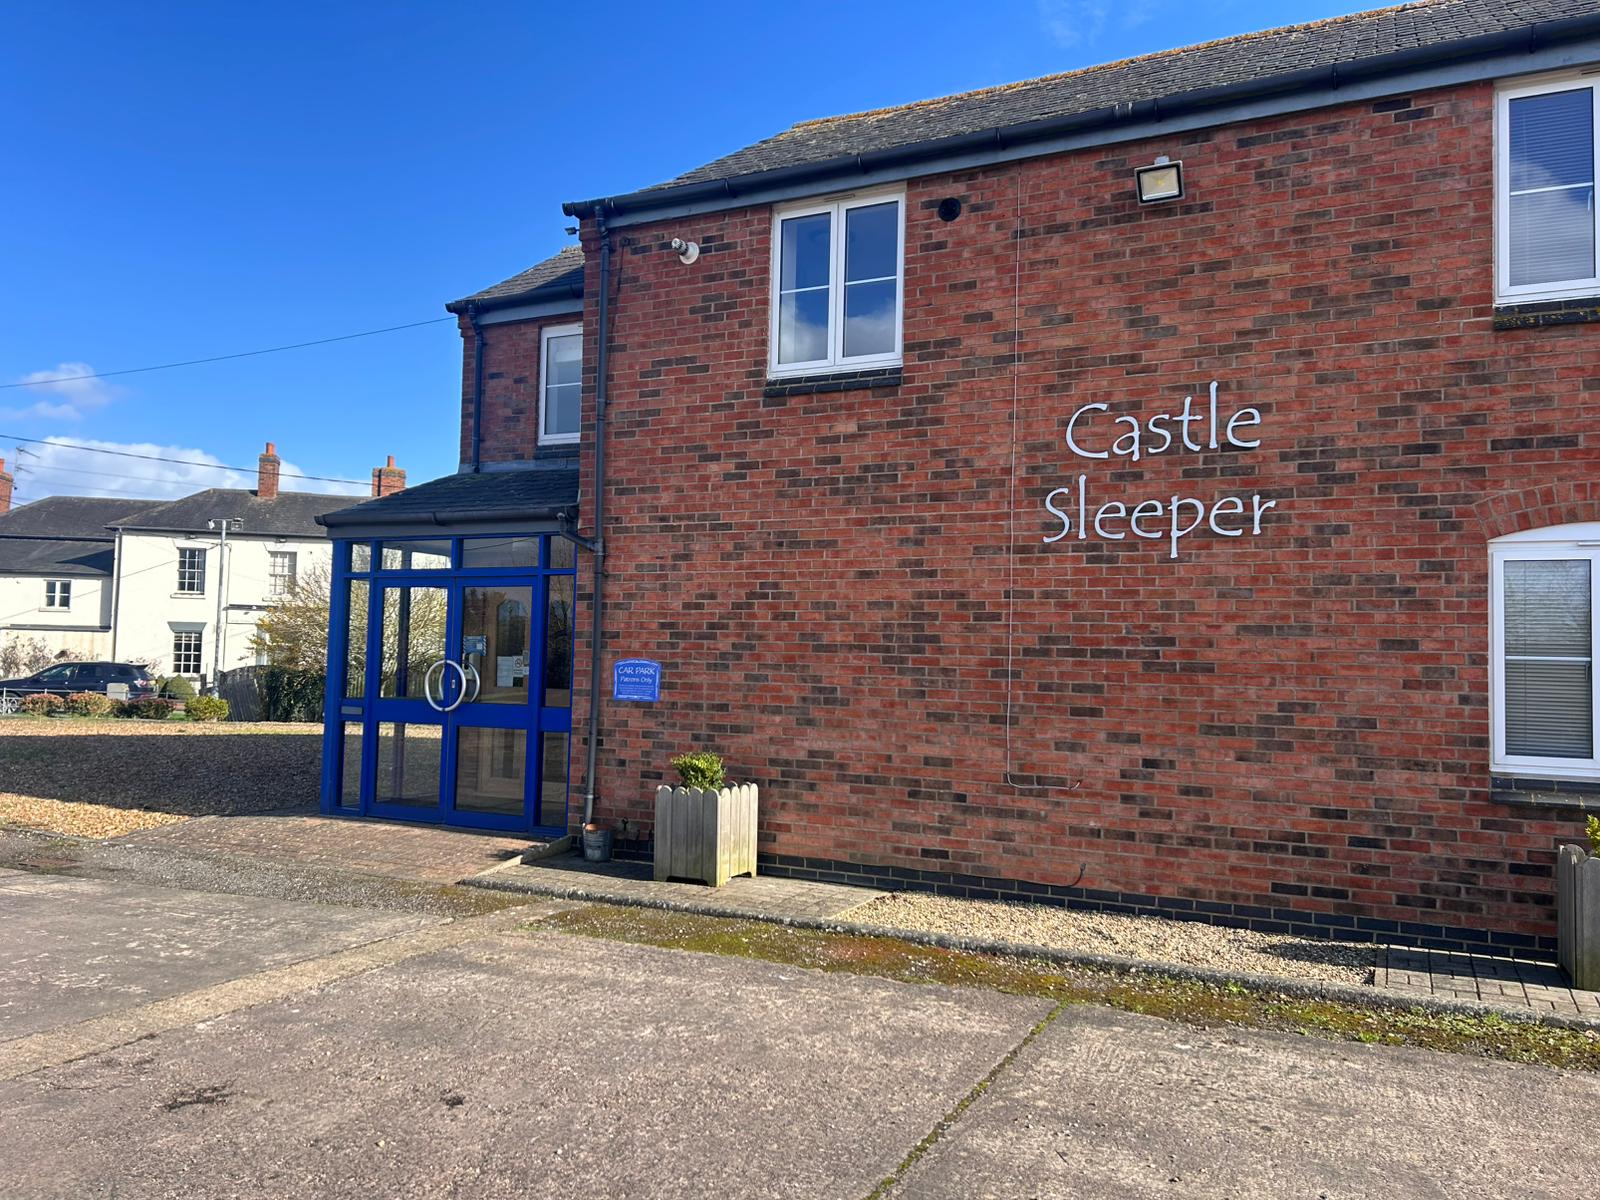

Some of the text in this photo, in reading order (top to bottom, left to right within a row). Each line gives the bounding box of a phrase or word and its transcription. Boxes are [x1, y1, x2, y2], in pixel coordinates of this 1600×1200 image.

[1065, 380, 1261, 461] Castle
[1042, 474, 1276, 559] Sleeper
[618, 666, 656, 675] CAR PARK
[640, 676, 653, 684] Only
